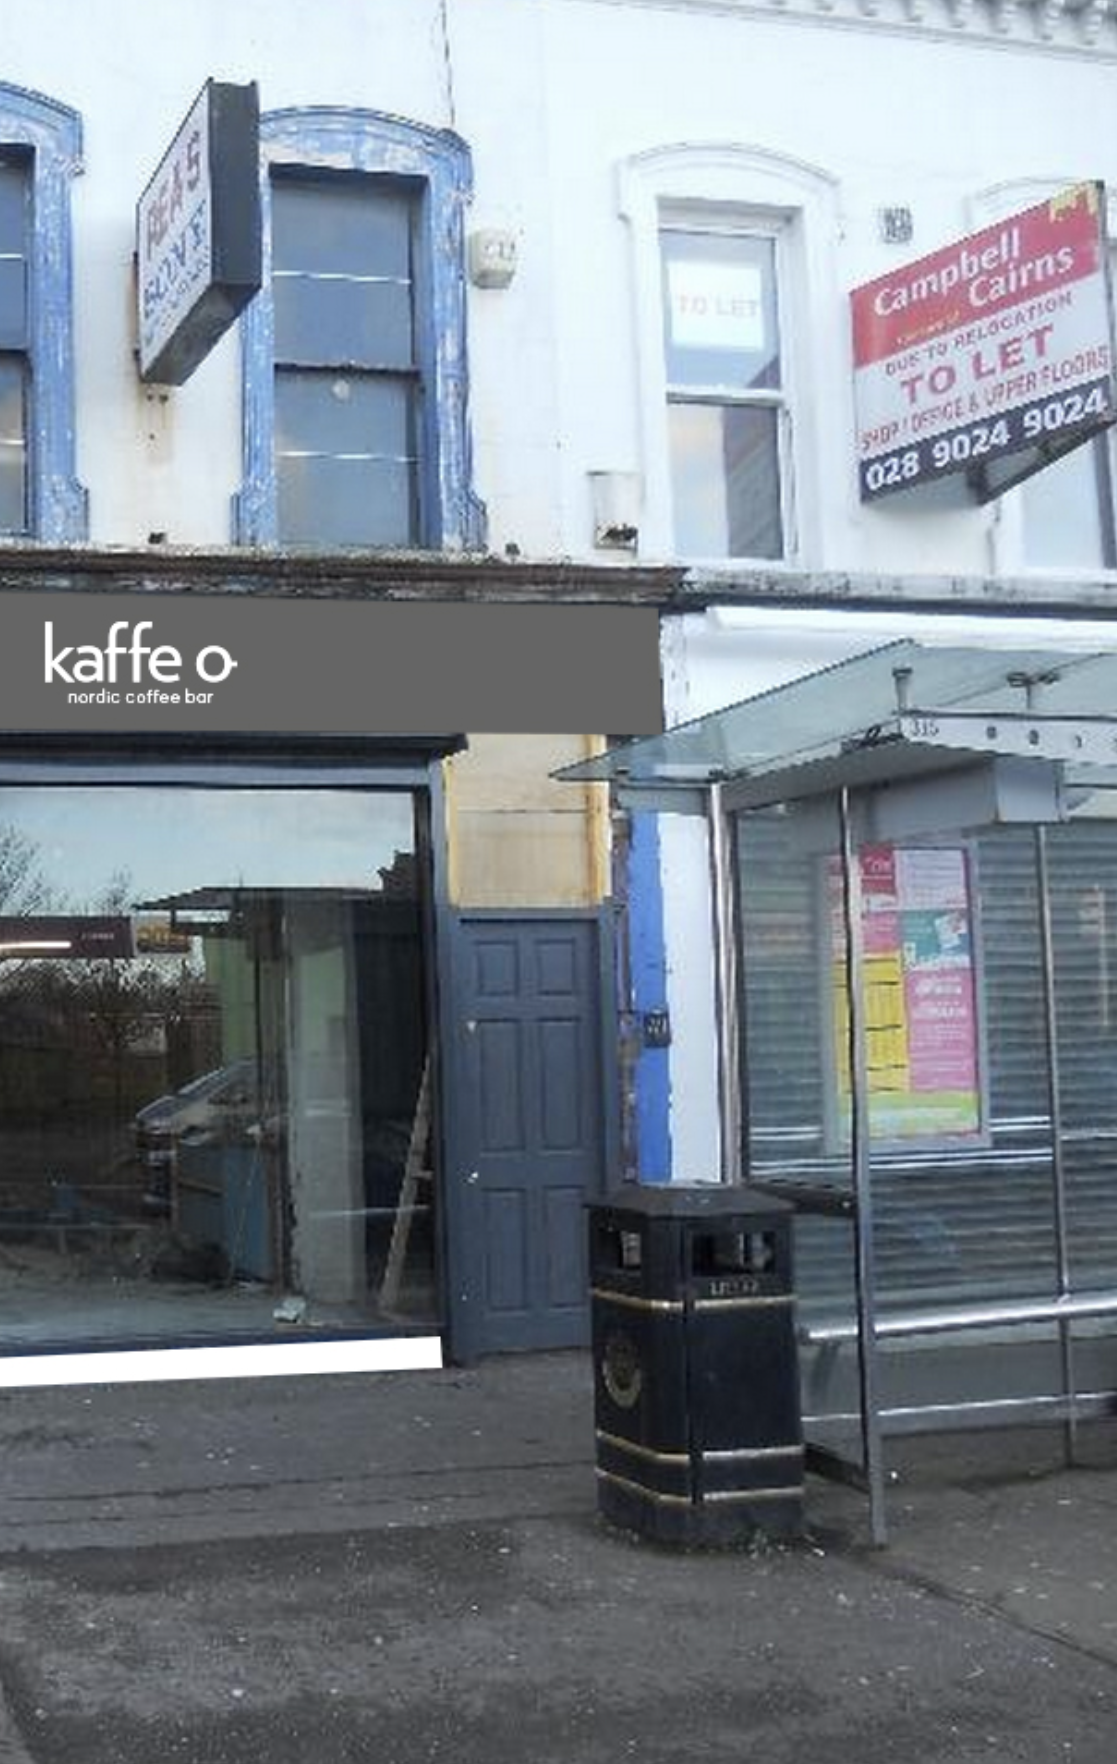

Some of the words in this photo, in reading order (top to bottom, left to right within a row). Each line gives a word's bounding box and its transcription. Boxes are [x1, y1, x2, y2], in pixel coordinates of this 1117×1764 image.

[874, 227, 1019, 316] Campbell
[969, 246, 1074, 307] Cairns
[886, 353, 920, 376] DUE
[927, 342, 948, 359] TO
[955, 292, 1072, 349] RELOCATION
[901, 365, 956, 404] TO
[972, 323, 1054, 381] LET
[911, 403, 962, 433] OFFICE
[986, 371, 1037, 406] UPPER
[1042, 345, 1109, 384] FLOORS
[865, 452, 920, 492] 028
[933, 421, 1011, 468] 9024
[1024, 387, 1108, 438] 9024
[44, 621, 183, 683] kaffe
[67, 688, 120, 704] nordic
[126, 688, 181, 704] coffee
[185, 688, 214, 704] bar
